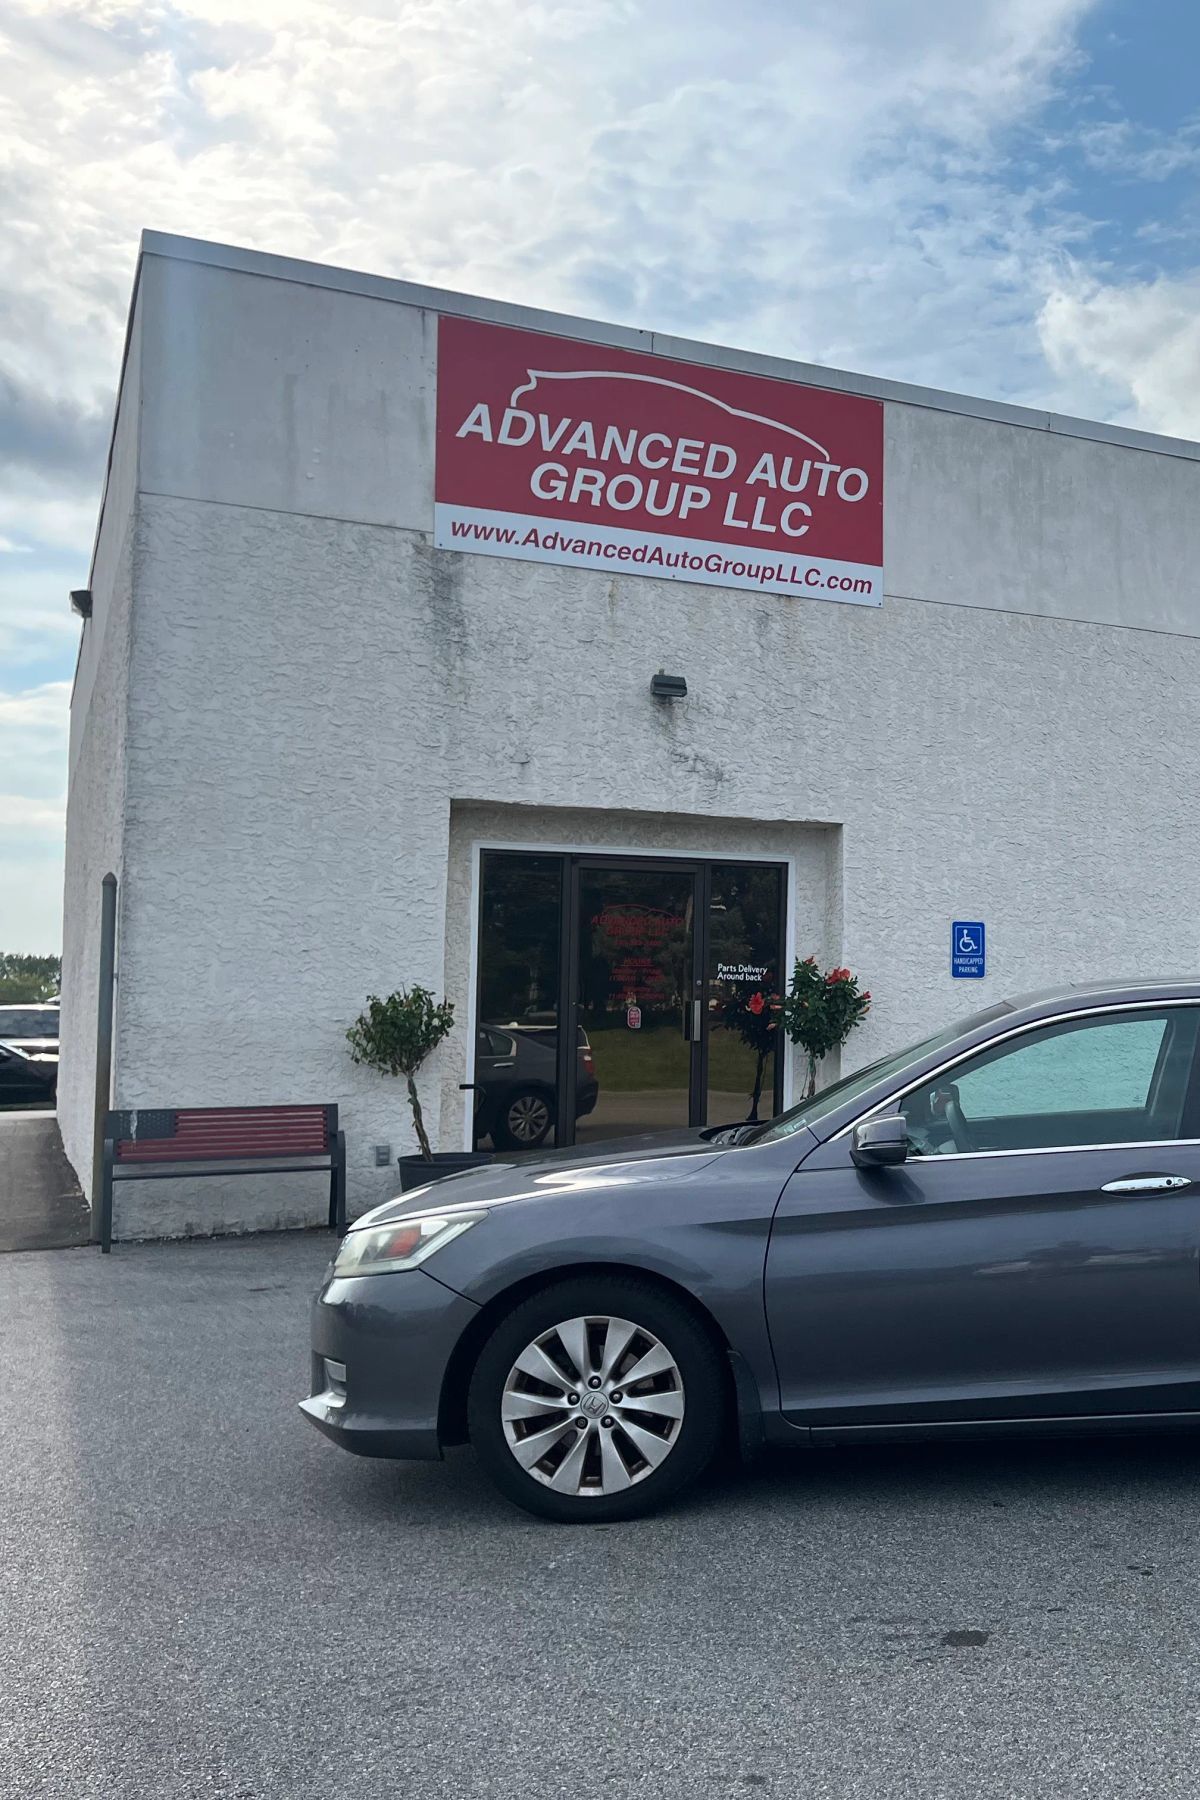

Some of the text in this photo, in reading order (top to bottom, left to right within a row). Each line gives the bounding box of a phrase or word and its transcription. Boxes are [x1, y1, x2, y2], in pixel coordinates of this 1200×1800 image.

[455, 403, 870, 503] ADVANCED AUTO
[530, 462, 813, 538] GROUP LLC
[450, 519, 873, 595] www.AdvancedAutoGroupLLC.com
[717, 963, 768, 975] Parts Delivery
[717, 972, 762, 981] Around back
[953, 957, 984, 965] HANDICAPPED
